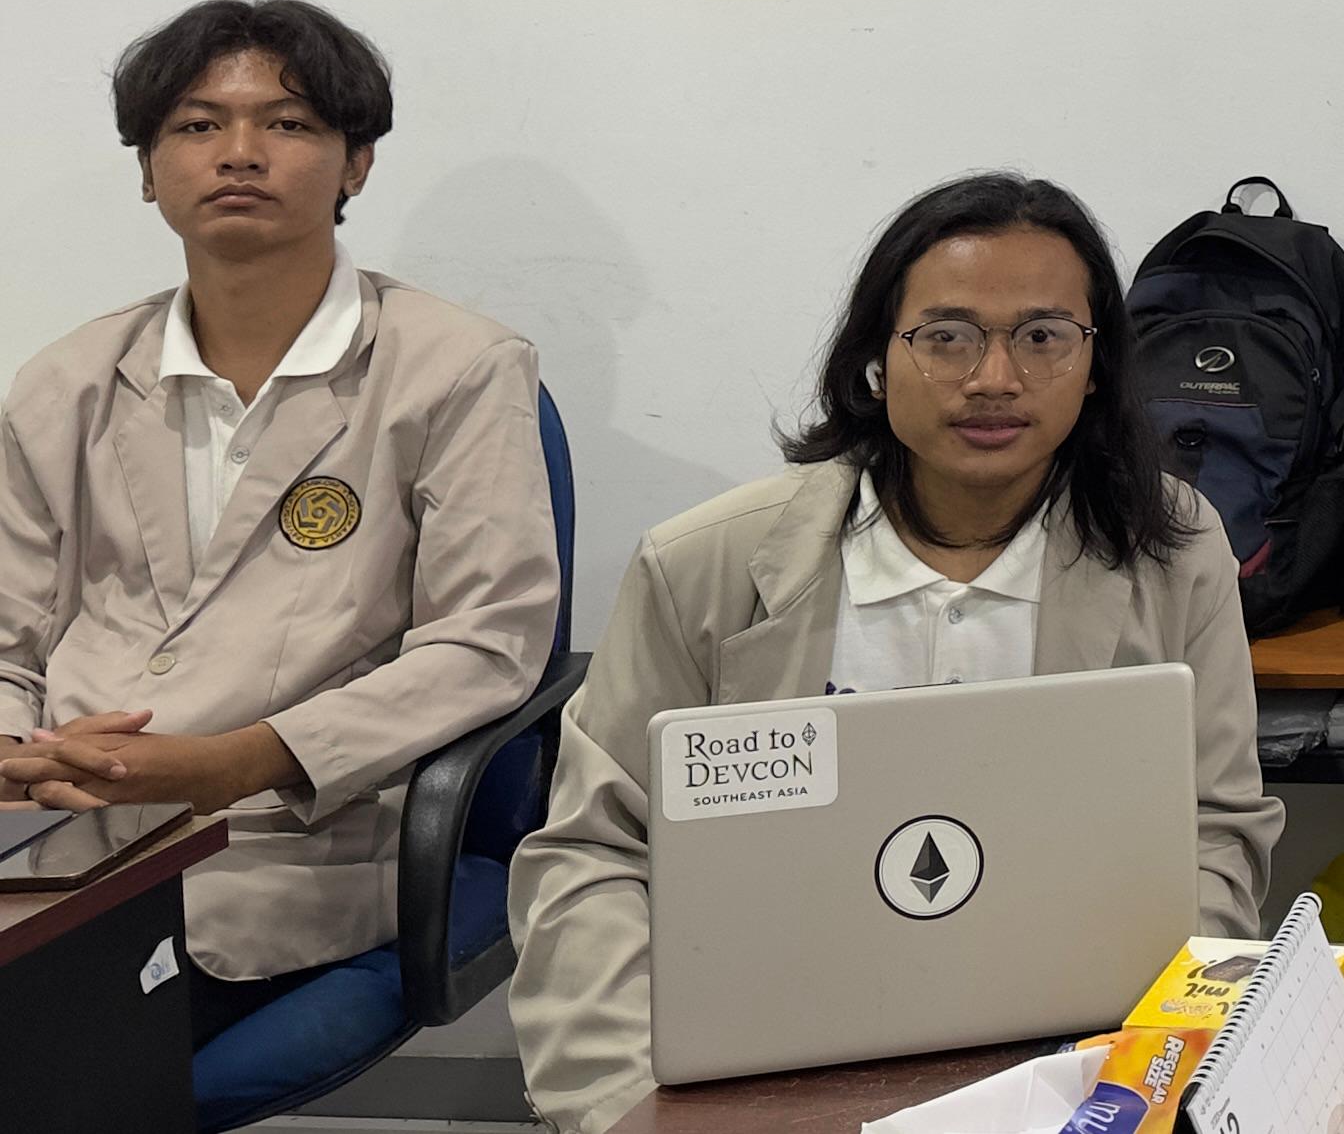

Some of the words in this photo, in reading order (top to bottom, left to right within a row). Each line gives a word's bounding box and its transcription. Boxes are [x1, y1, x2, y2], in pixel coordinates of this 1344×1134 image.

[684, 730, 760, 762] Road
[768, 728, 796, 750] to
[684, 751, 814, 788] DEVCON
[693, 789, 774, 807] SOUTHEAST
[777, 786, 809, 798] ASIA
[1143, 1054, 1166, 1088] SIZE
[1151, 1035, 1186, 1104] REGULAR
